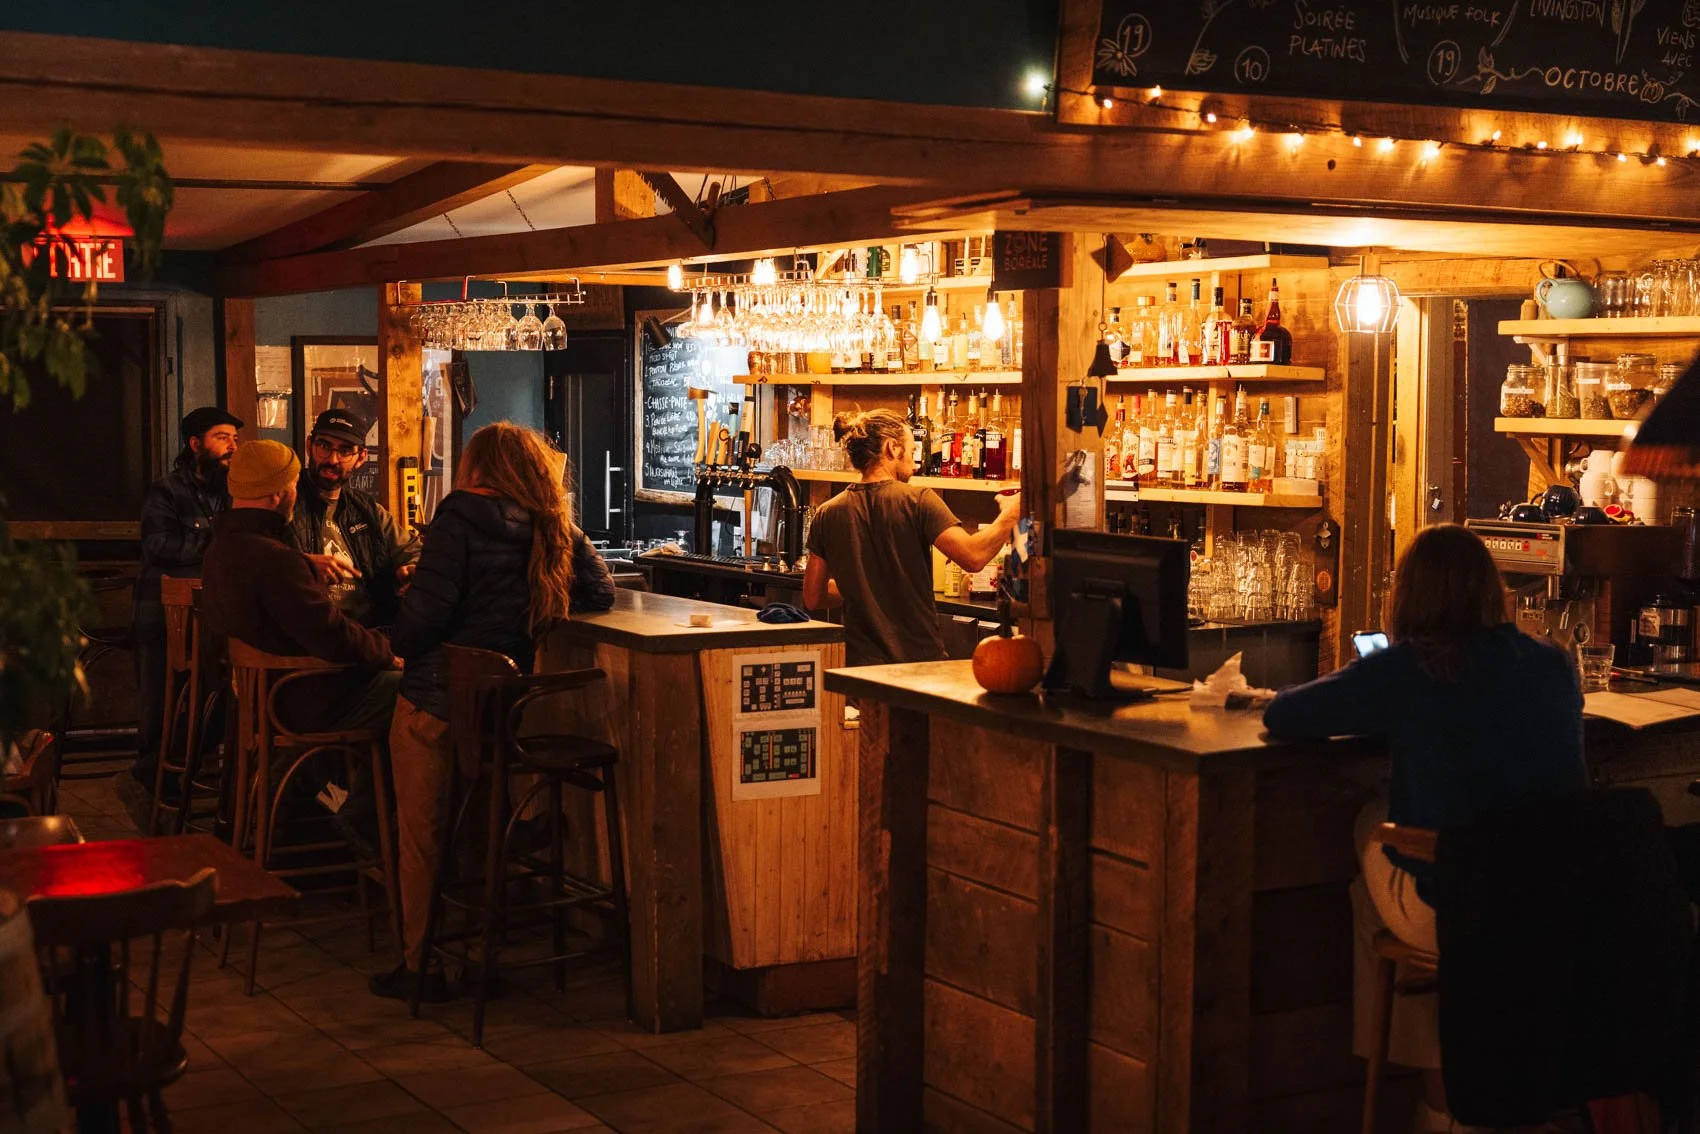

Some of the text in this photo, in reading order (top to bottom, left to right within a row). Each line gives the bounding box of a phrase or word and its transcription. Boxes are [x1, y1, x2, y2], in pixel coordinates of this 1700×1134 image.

[1293, 0, 1356, 31] SOIRÉE
[1403, 3, 1500, 27] MUSIQUE FOLK
[1289, 35, 1367, 64] PLATINES
[1656, 27, 1696, 50] VIENS
[1543, 66, 1640, 95] OCTOBRE
